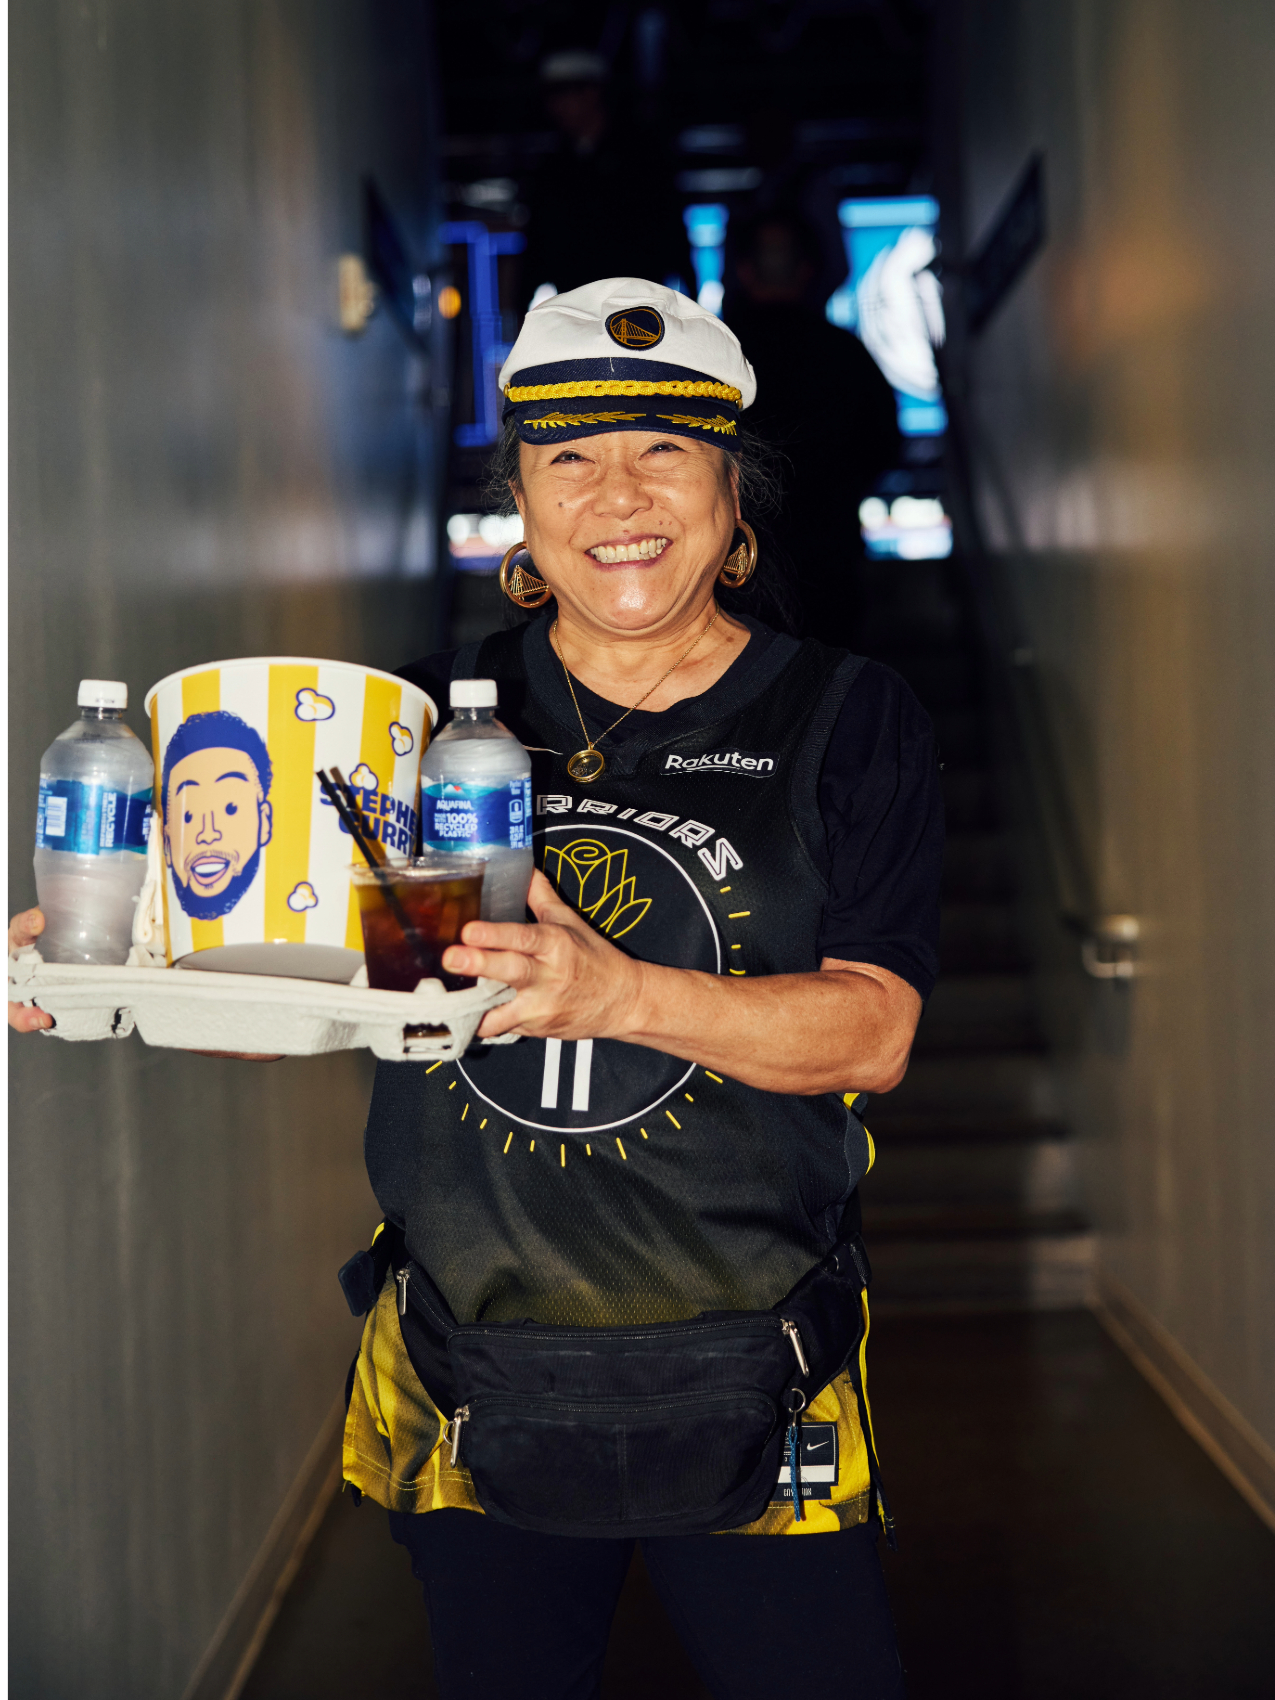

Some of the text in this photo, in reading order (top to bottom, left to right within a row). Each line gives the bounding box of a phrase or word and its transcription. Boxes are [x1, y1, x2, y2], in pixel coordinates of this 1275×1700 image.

[665, 752, 774, 773] Rakuten
[436, 800, 473, 811] AQUAFINA
[105, 792, 117, 848] RECYCLE
[446, 812, 478, 824] 100%
[434, 823, 478, 832] RECYCLED
